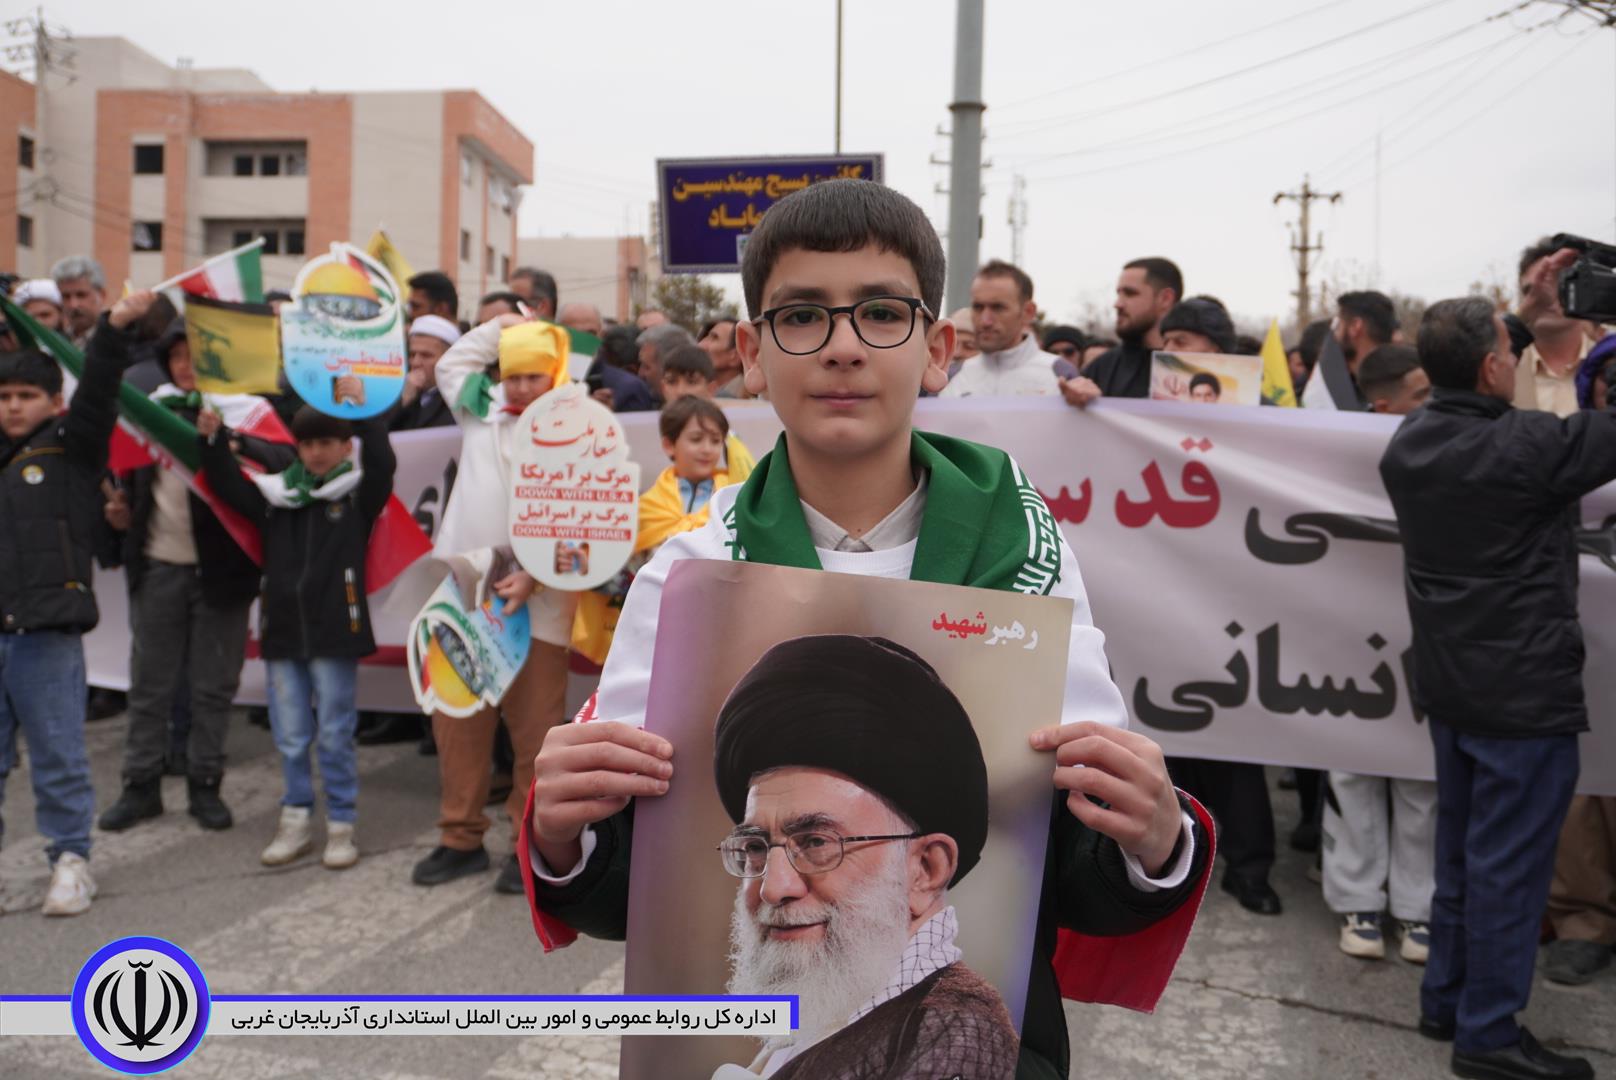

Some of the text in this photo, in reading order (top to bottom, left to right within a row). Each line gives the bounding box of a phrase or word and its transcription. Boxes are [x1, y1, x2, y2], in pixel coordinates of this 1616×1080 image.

[673, 172, 764, 200] مهندسین
[520, 463, 631, 489] مرگ بر آمریکا
[518, 487, 557, 499] DOWN
[561, 489, 593, 501] WITH
[518, 503, 630, 526] مرگ بر اسرائیل
[515, 524, 629, 541] DOWN WITH ISRAEL
[932, 611, 1038, 650] رهبر شهید
